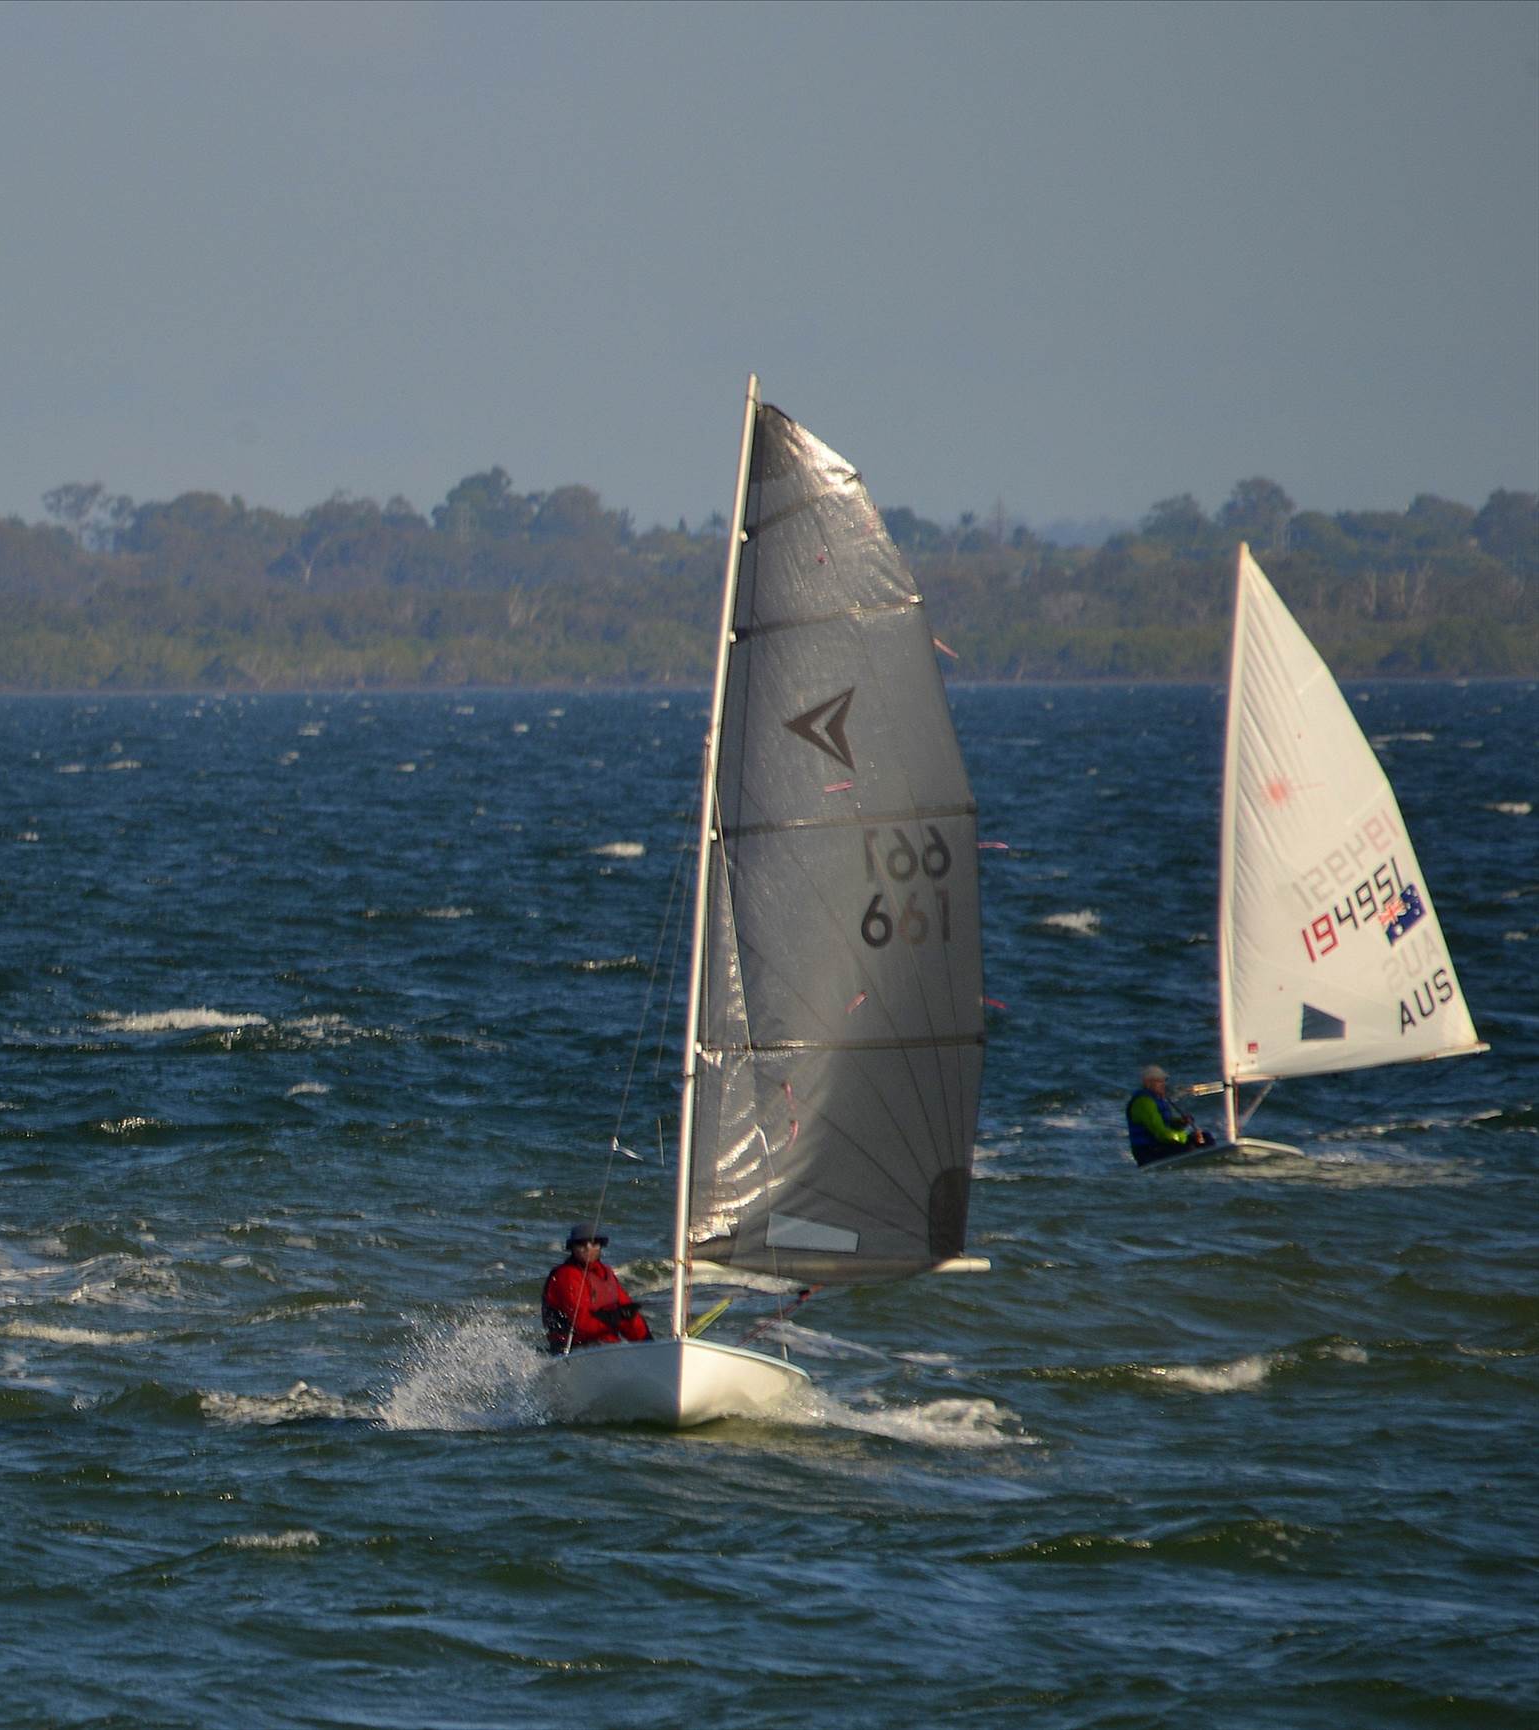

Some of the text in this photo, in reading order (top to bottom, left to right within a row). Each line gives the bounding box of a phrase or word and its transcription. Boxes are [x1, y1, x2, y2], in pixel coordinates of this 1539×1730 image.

[861, 888, 952, 950] 661
[1300, 855, 1405, 964] 194951
[1397, 966, 1455, 1037] AUS
